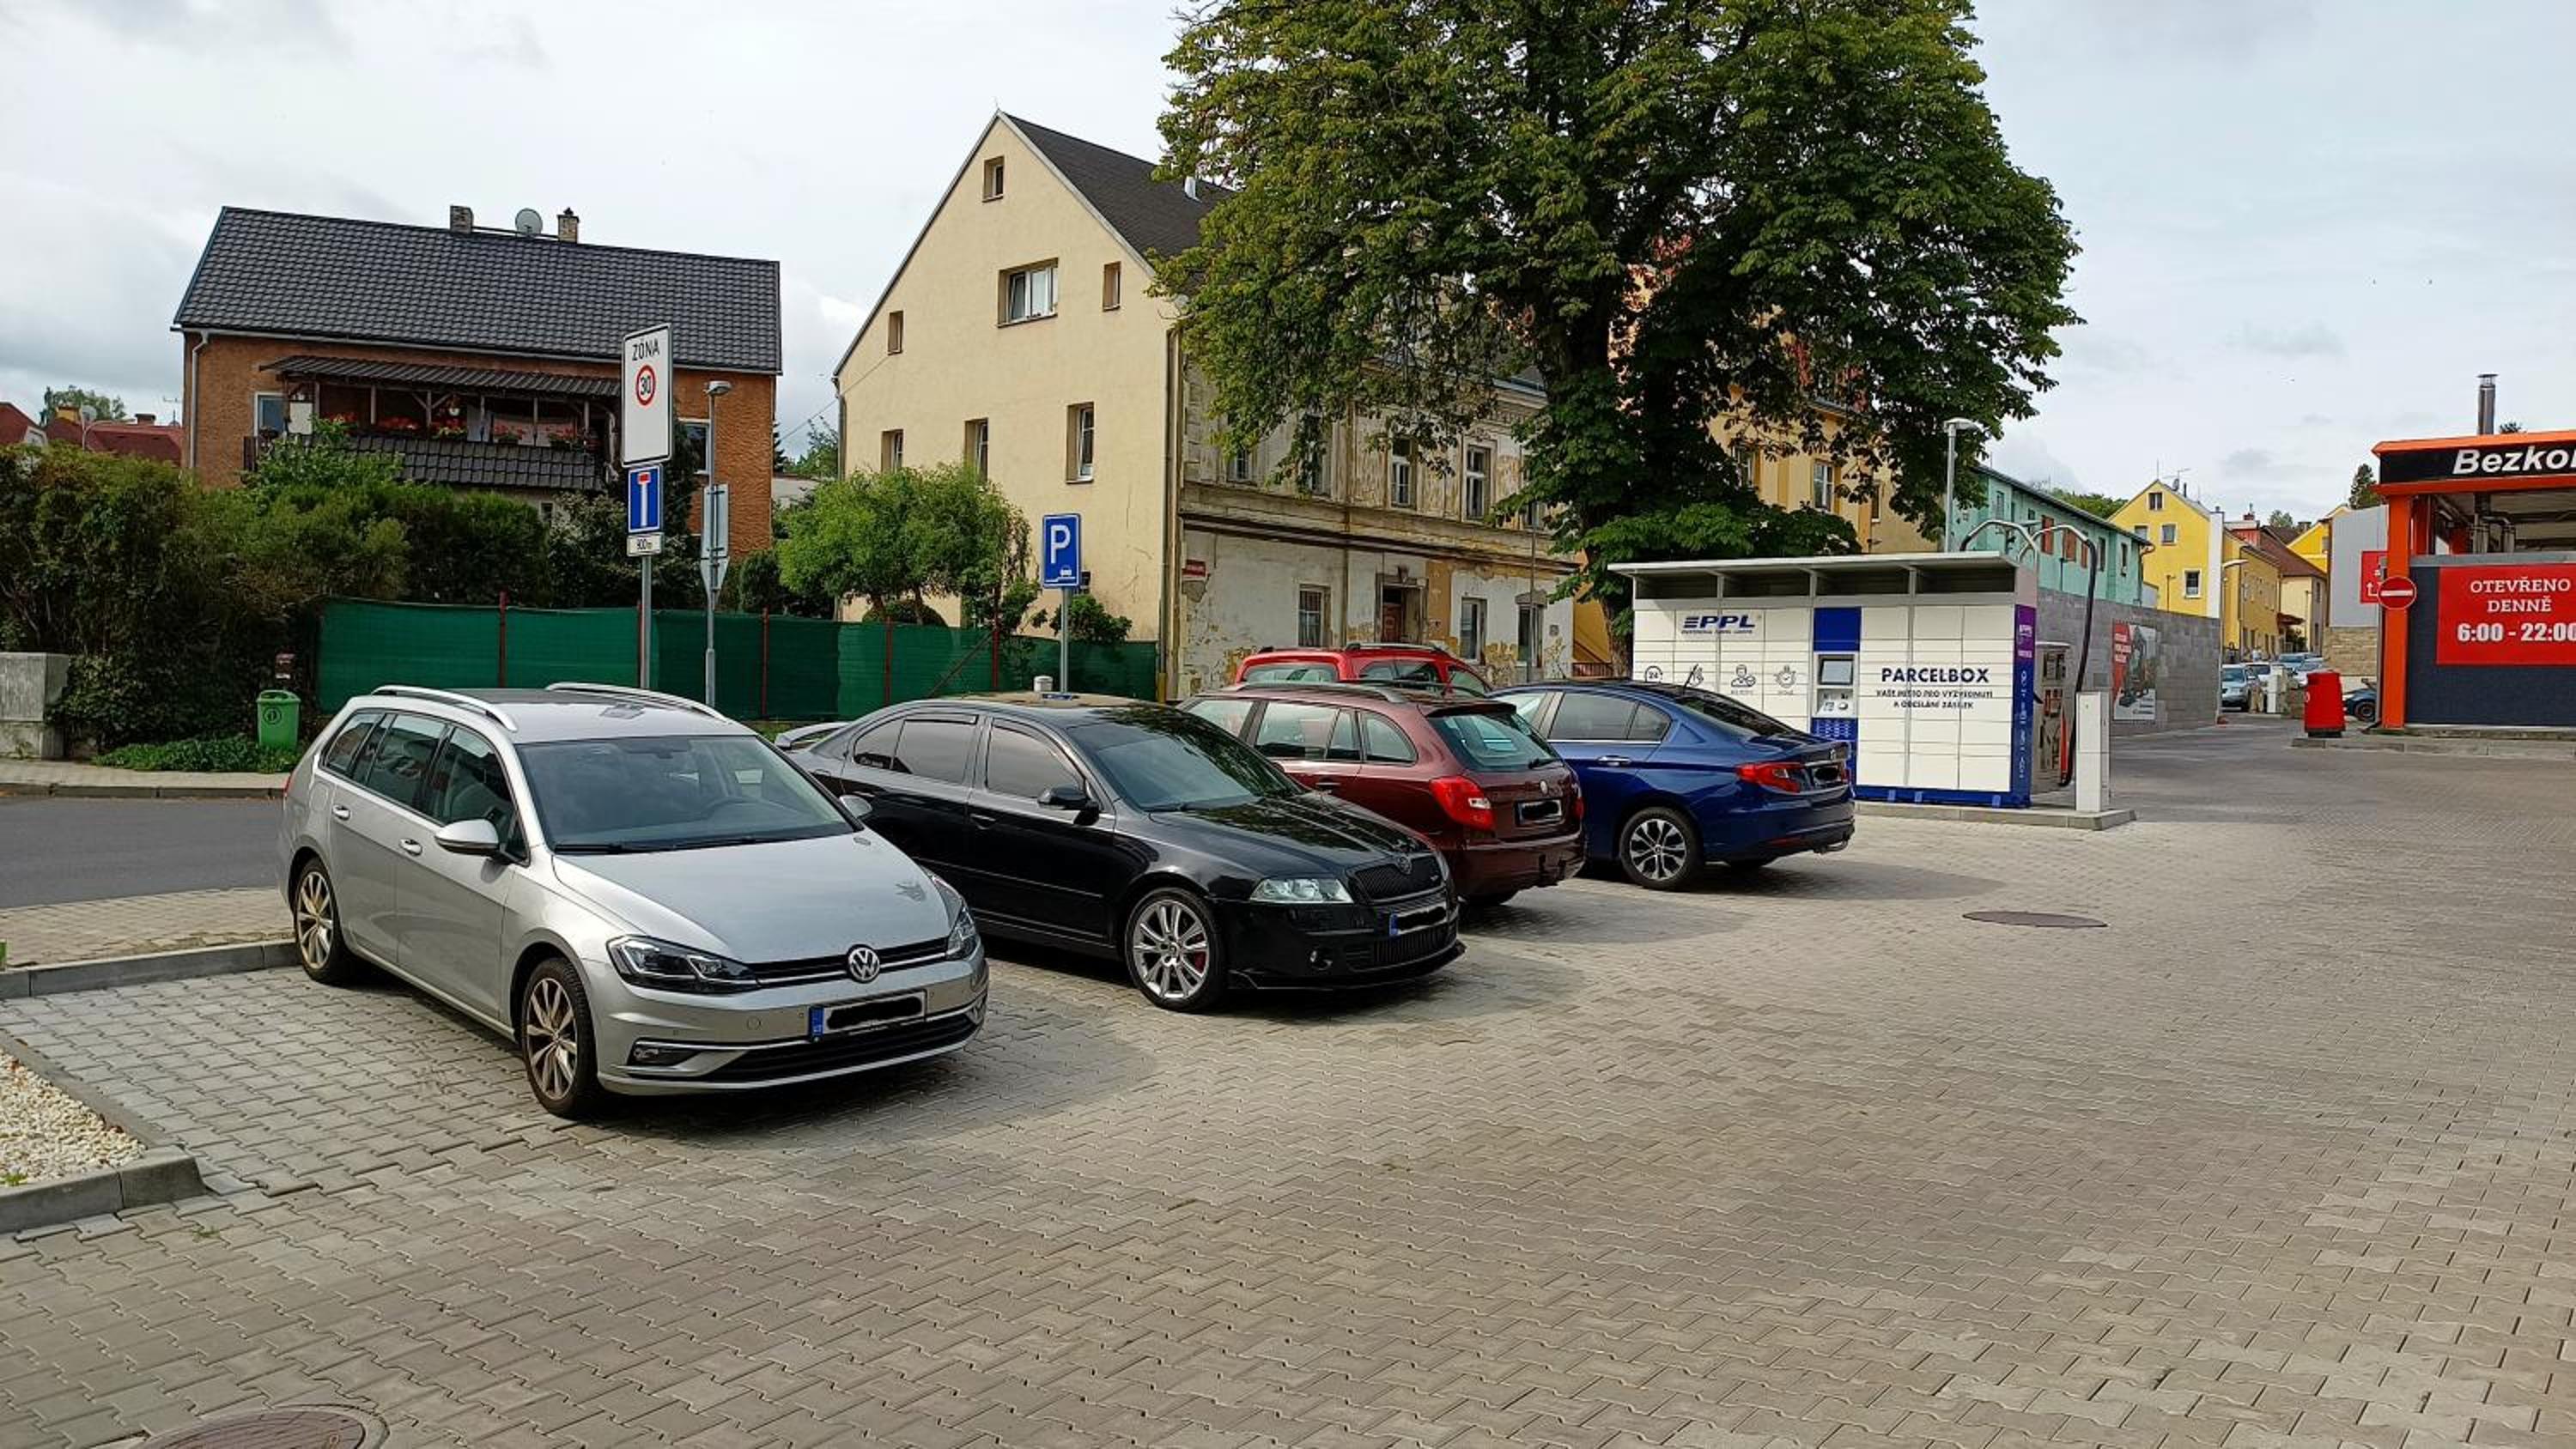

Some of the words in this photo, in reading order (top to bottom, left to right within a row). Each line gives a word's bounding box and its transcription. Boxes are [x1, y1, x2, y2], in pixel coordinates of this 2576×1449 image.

[640, 375, 652, 396] 30
[1051, 524, 1071, 564] P
[2470, 576, 2572, 594] OTEVŘENO
[2486, 595, 2552, 614] DENNĚ
[1699, 615, 1756, 629] PPL
[2458, 622, 2504, 642] 6:00
[2520, 622, 2576, 641] 22:00
[1880, 668, 1990, 683] PARCELBOX
